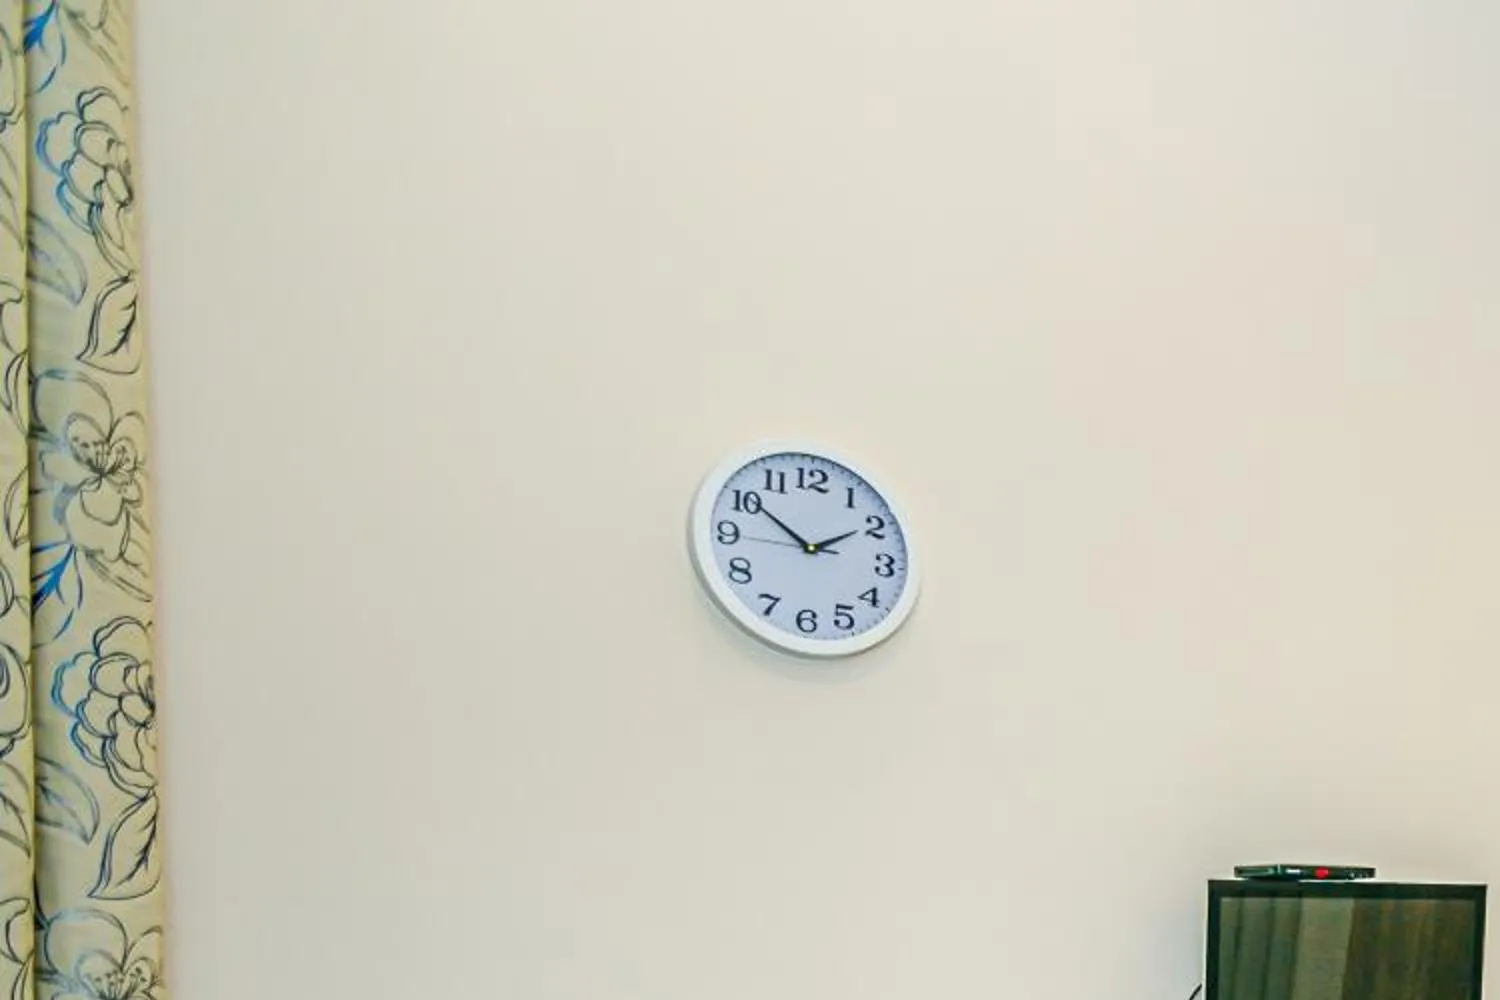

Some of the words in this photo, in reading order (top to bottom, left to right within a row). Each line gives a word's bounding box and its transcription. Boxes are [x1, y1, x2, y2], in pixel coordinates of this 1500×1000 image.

[764, 469, 787, 494] 11
[796, 468, 829, 494] 12
[732, 490, 762, 514] 10
[845, 488, 855, 508] 1
[717, 520, 740, 544] 9
[865, 516, 885, 539] 2
[728, 557, 752, 584] 8
[875, 554, 895, 577] 3
[758, 594, 782, 616] 7
[858, 587, 880, 607] 4
[796, 609, 818, 632] 6
[834, 604, 855, 630] 5
